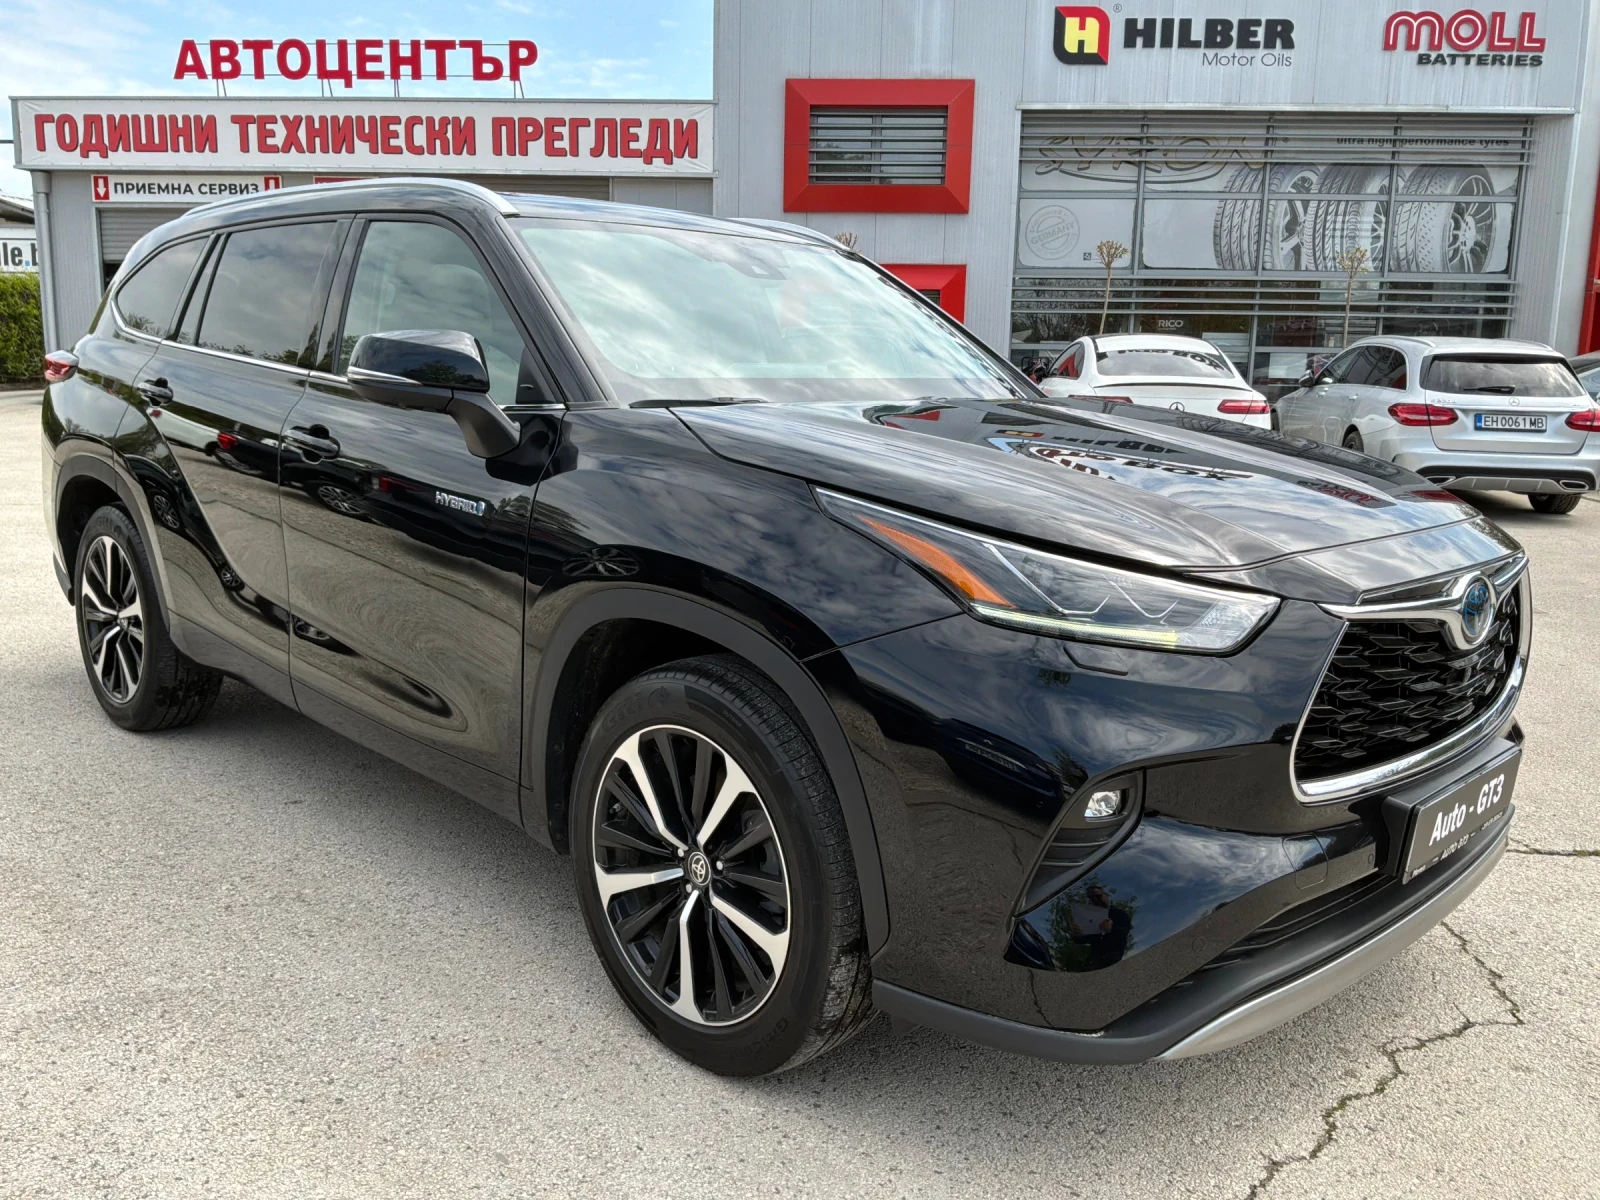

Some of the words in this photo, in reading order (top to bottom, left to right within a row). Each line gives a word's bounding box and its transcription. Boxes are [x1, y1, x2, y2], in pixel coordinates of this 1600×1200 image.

[1123, 18, 1295, 49] HILBER
[1383, 9, 1546, 53] MOLL
[173, 38, 538, 88] АВТОЦЕНТЪР
[1201, 52, 1256, 67] Motor
[1260, 52, 1292, 67] Oils
[1417, 53, 1543, 67] BATTERIES
[34, 113, 218, 158] ГОДИШНИ
[231, 114, 476, 156] ТЕХНИЧЕСКИ
[492, 116, 698, 165] ПРЕГЛЕДИ
[1400, 137, 1475, 148] performance
[1479, 138, 1510, 148] tyres
[113, 182, 194, 196] ПРИЕМНА
[197, 183, 260, 196] СЕРВИЗ
[1031, 221, 1074, 245] GERMANY
[1158, 319, 1184, 328] RICO
[1483, 415, 1499, 427] EH
[1500, 416, 1527, 428] 0061
[1529, 417, 1544, 429] MB
[435, 491, 477, 515] HYBRID
[1428, 802, 1467, 847] Auto
[1476, 773, 1505, 815] GT3
